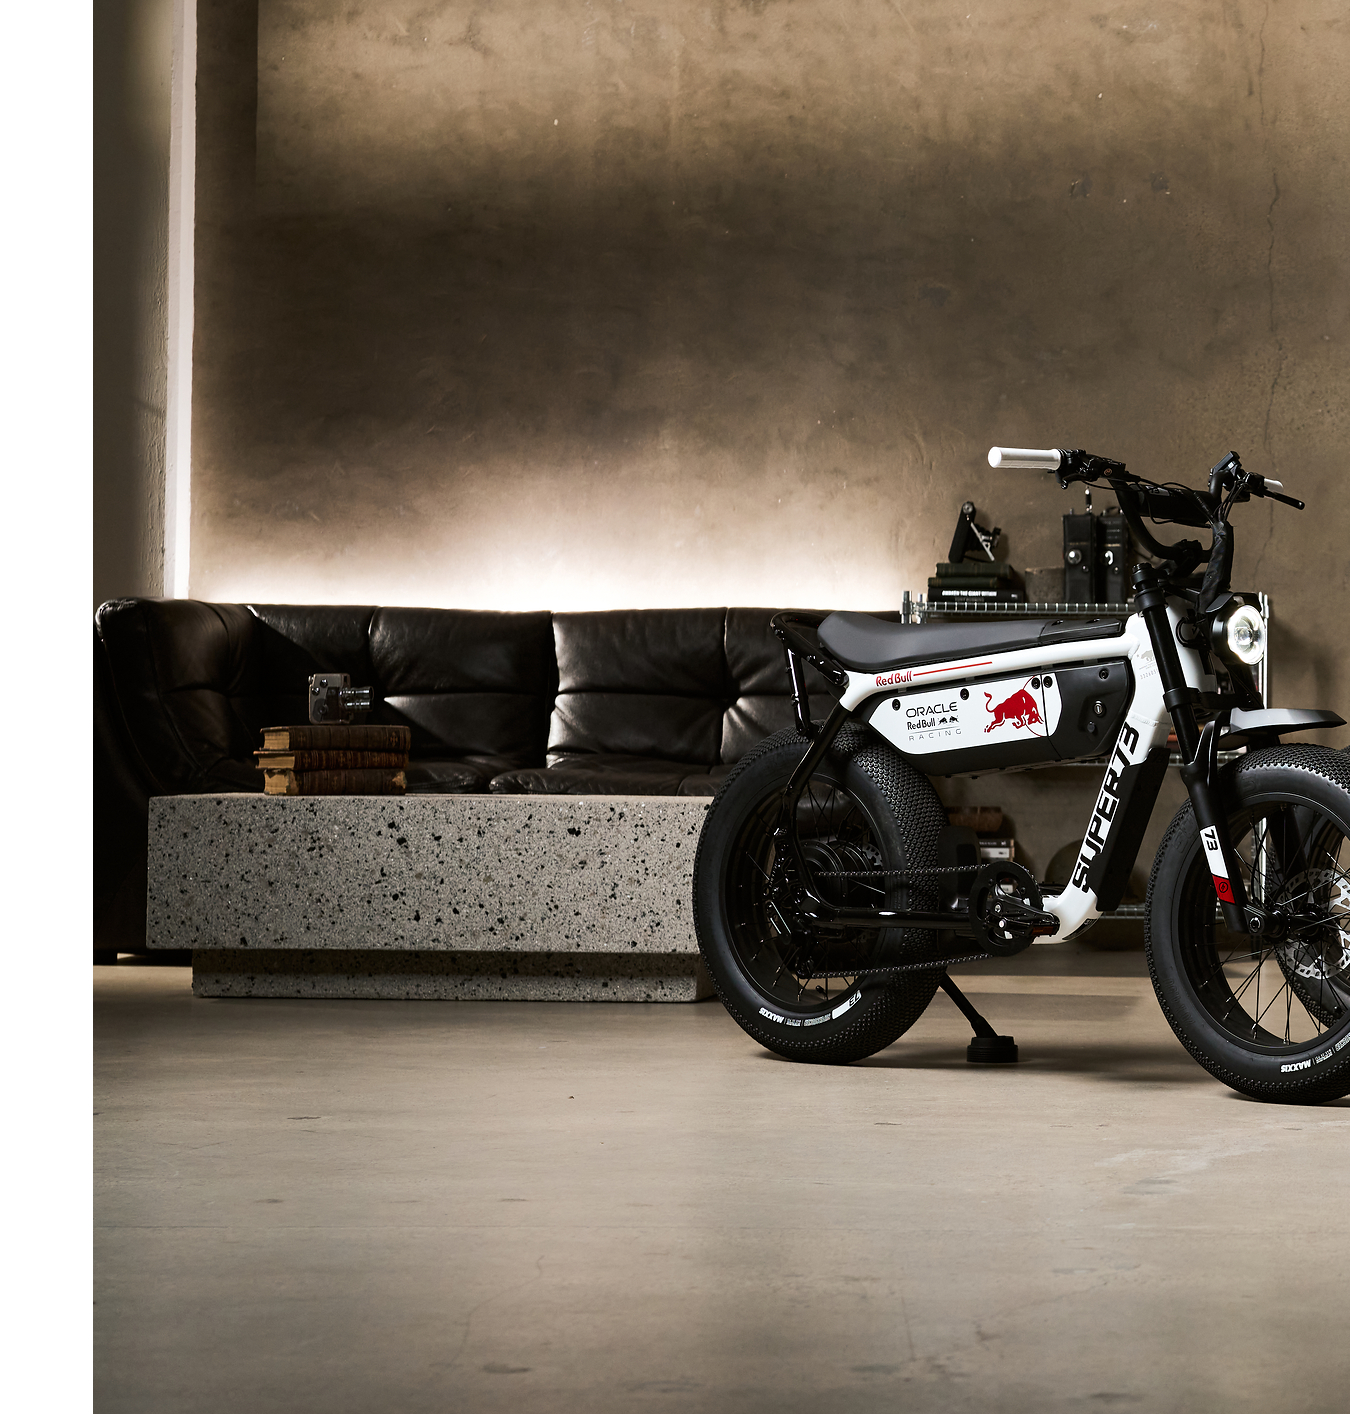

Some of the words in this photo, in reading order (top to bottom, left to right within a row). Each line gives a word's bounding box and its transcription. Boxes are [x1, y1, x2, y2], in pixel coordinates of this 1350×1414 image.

[905, 701, 958, 718] ORACLE
[908, 728, 962, 741] RACING
[1072, 721, 1140, 894] SUPER73
[1204, 829, 1219, 851] 73
[758, 1007, 785, 1024] MAXXIS
[1280, 1059, 1312, 1073] MAXXIS
